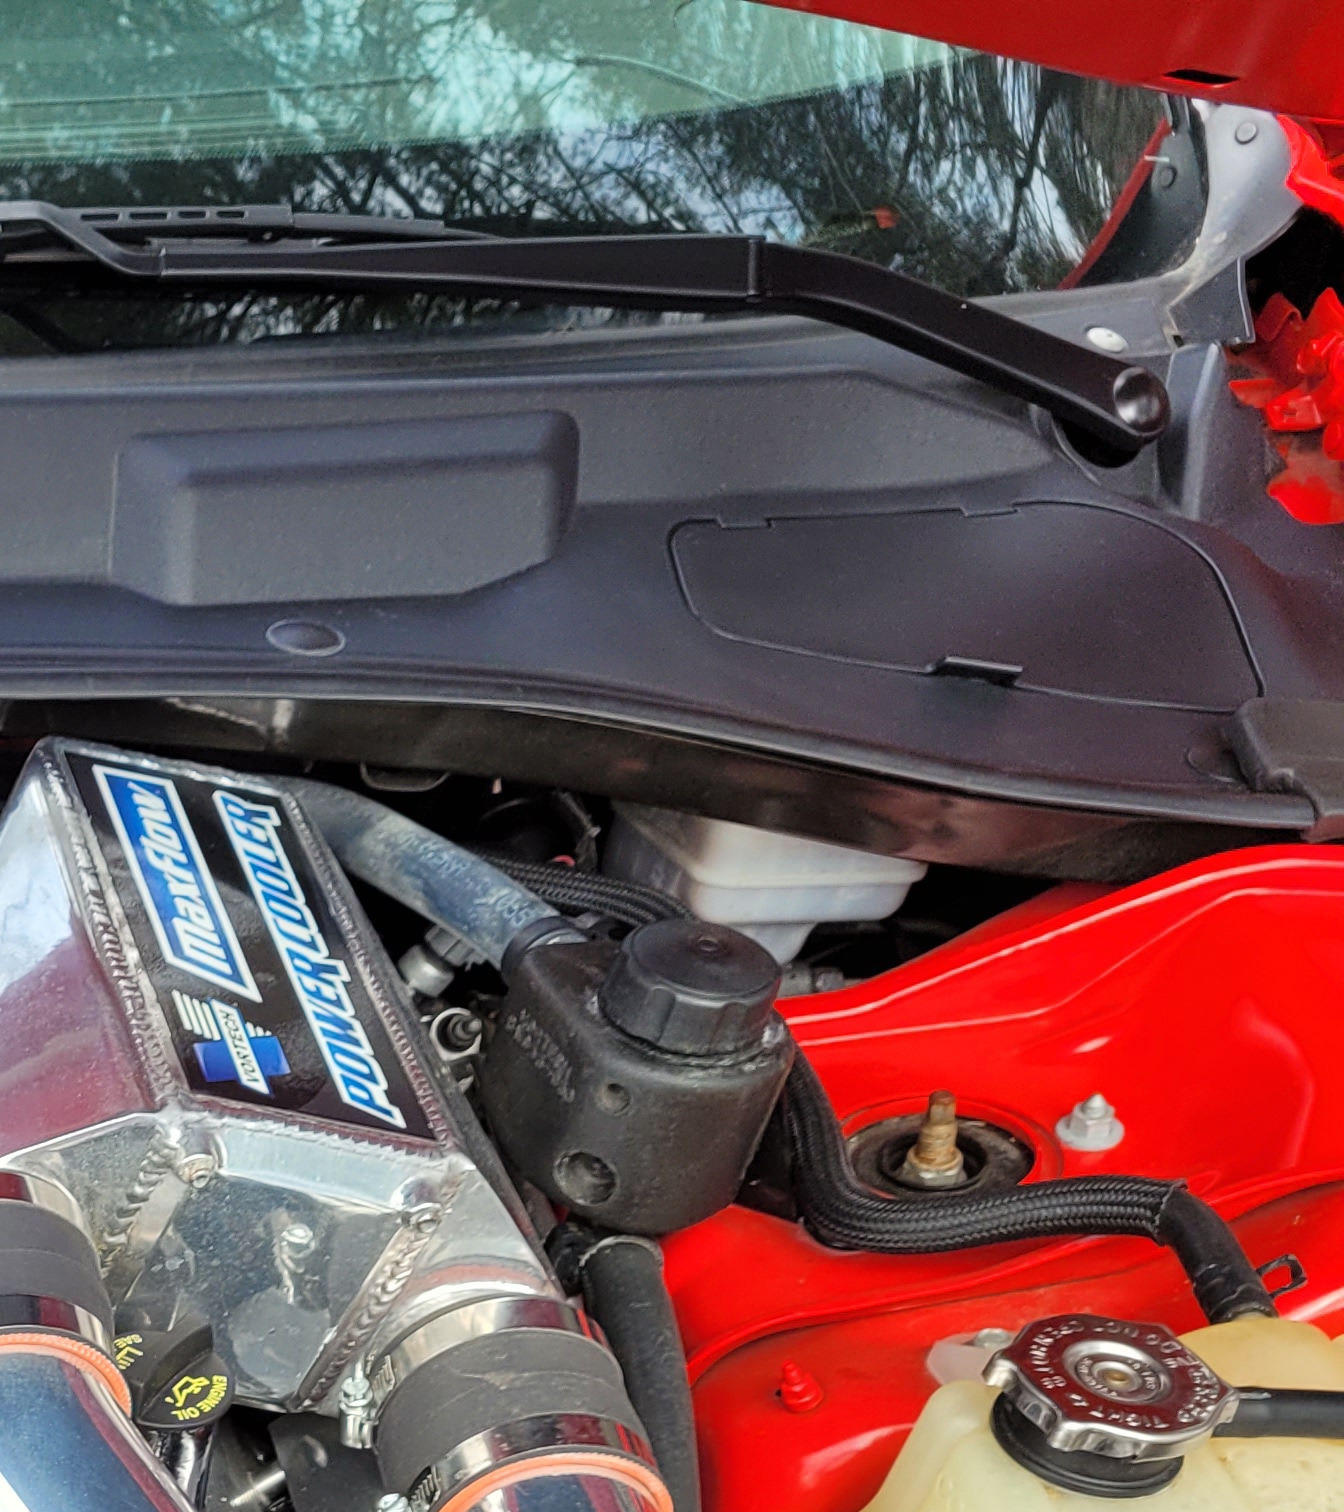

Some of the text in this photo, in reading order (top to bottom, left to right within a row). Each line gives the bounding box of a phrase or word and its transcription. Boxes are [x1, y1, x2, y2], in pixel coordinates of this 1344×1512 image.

[219, 1010, 260, 1084] VORTECH
[170, 1375, 227, 1421] ENGINE OIL
